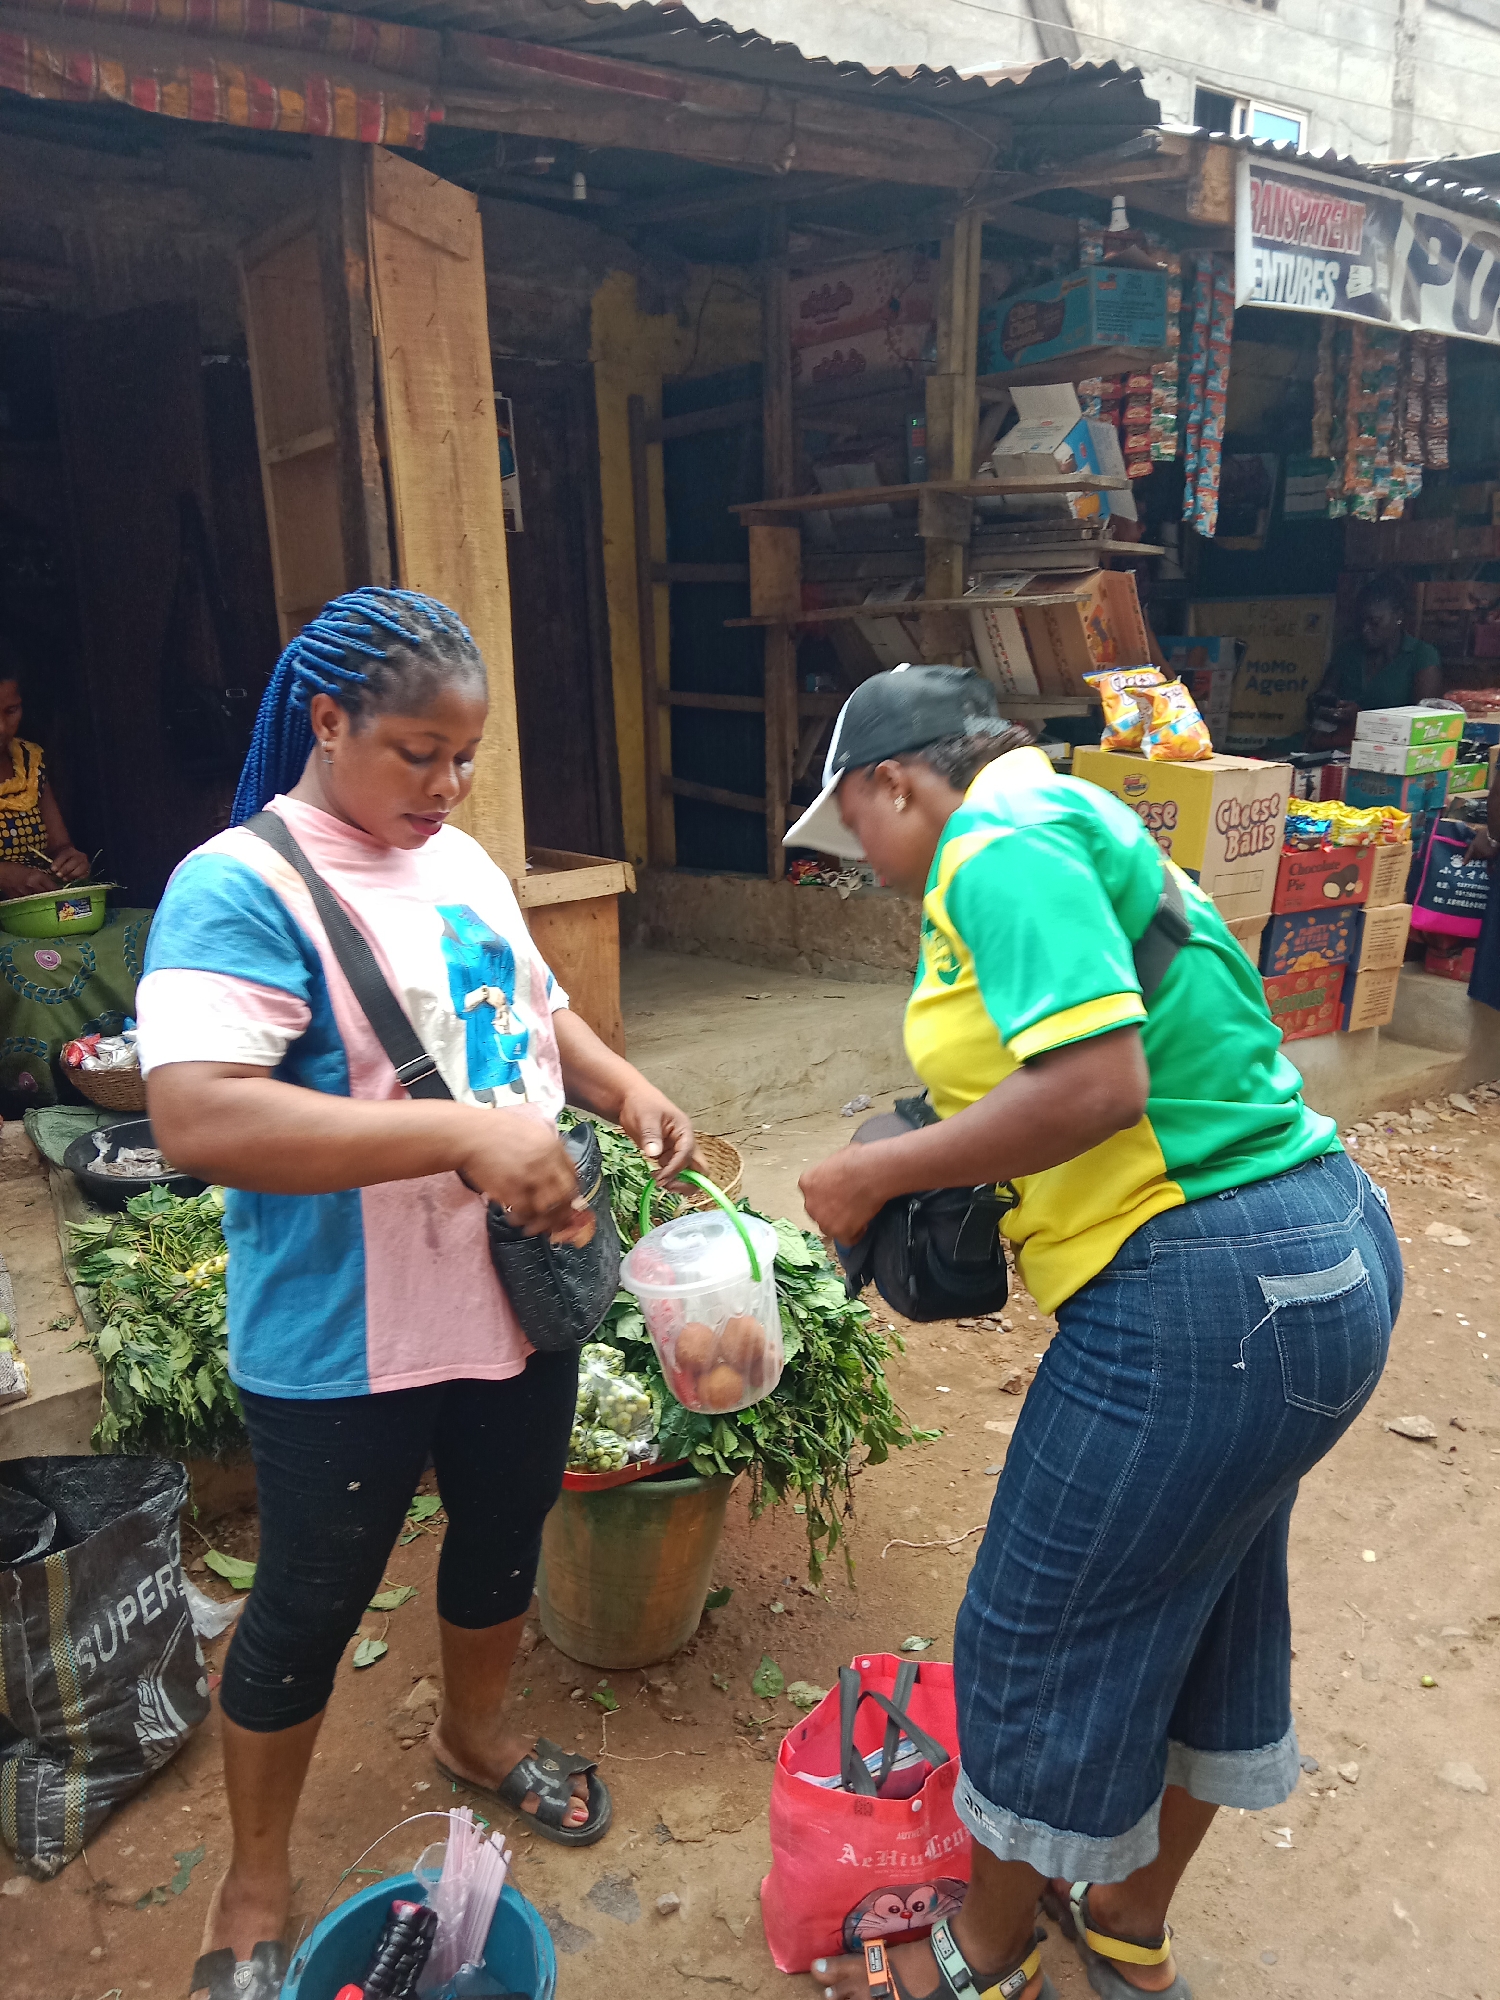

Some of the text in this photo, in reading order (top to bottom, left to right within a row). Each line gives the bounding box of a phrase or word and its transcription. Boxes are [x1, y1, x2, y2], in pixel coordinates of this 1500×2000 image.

[1245, 660, 1297, 674] MoMo
[1245, 676, 1308, 696] Agent
[1215, 792, 1281, 835] Cheese
[1224, 824, 1276, 862] Balls
[1288, 860, 1341, 876] Chocolate
[1286, 879, 1306, 891] Pie
